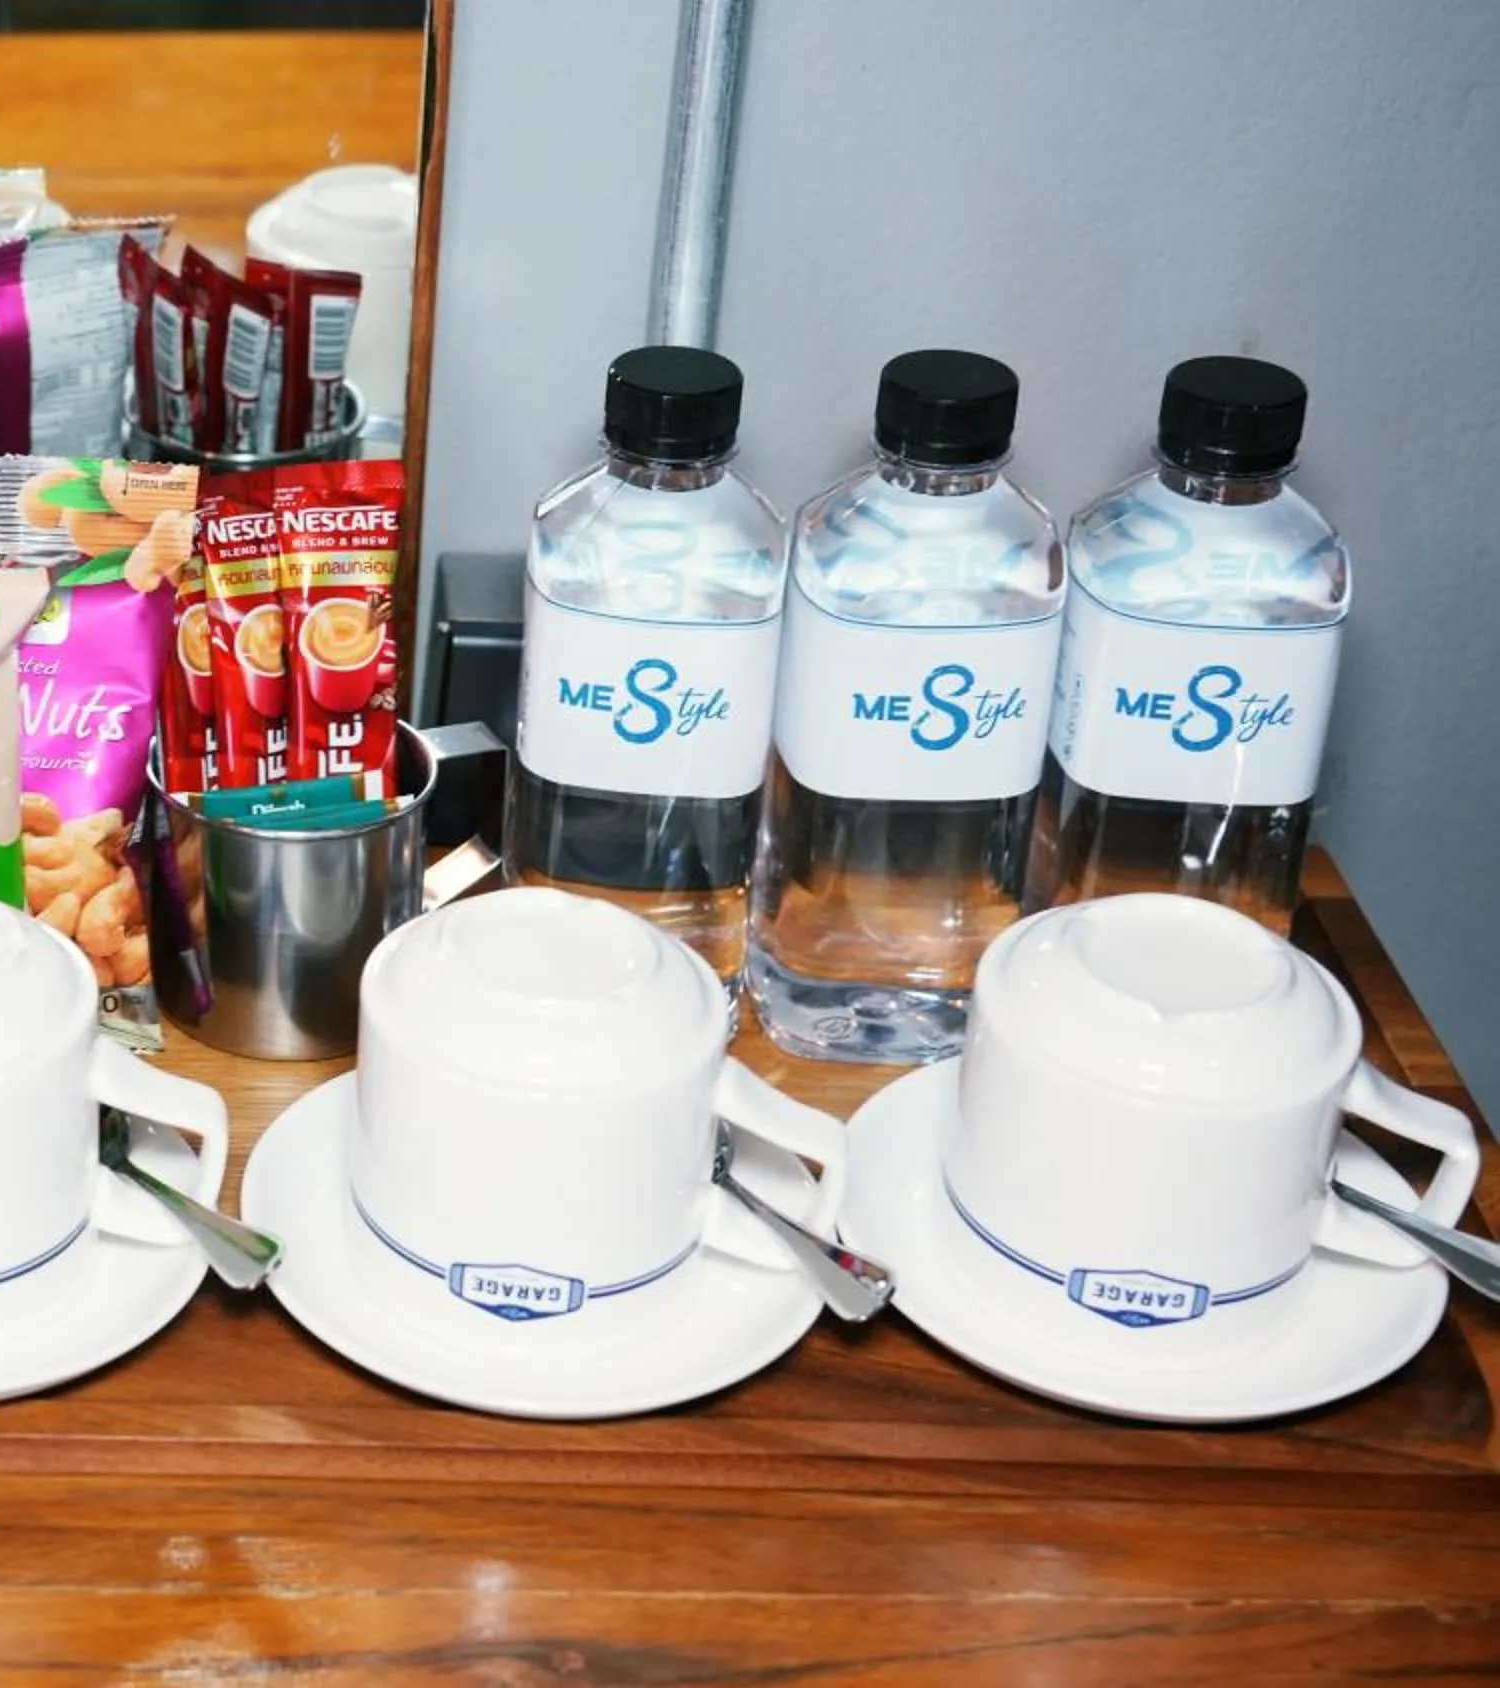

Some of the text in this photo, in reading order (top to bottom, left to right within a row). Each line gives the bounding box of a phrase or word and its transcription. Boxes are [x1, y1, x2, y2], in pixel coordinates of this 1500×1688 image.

[558, 659, 731, 744] ME Style
[853, 693, 912, 721] ME
[911, 664, 1026, 751] Style
[1115, 687, 1175, 720] ME
[1172, 665, 1295, 752] Style
[471, 1276, 562, 1302] GARAGE
[1092, 1281, 1186, 1308] GARAGE
